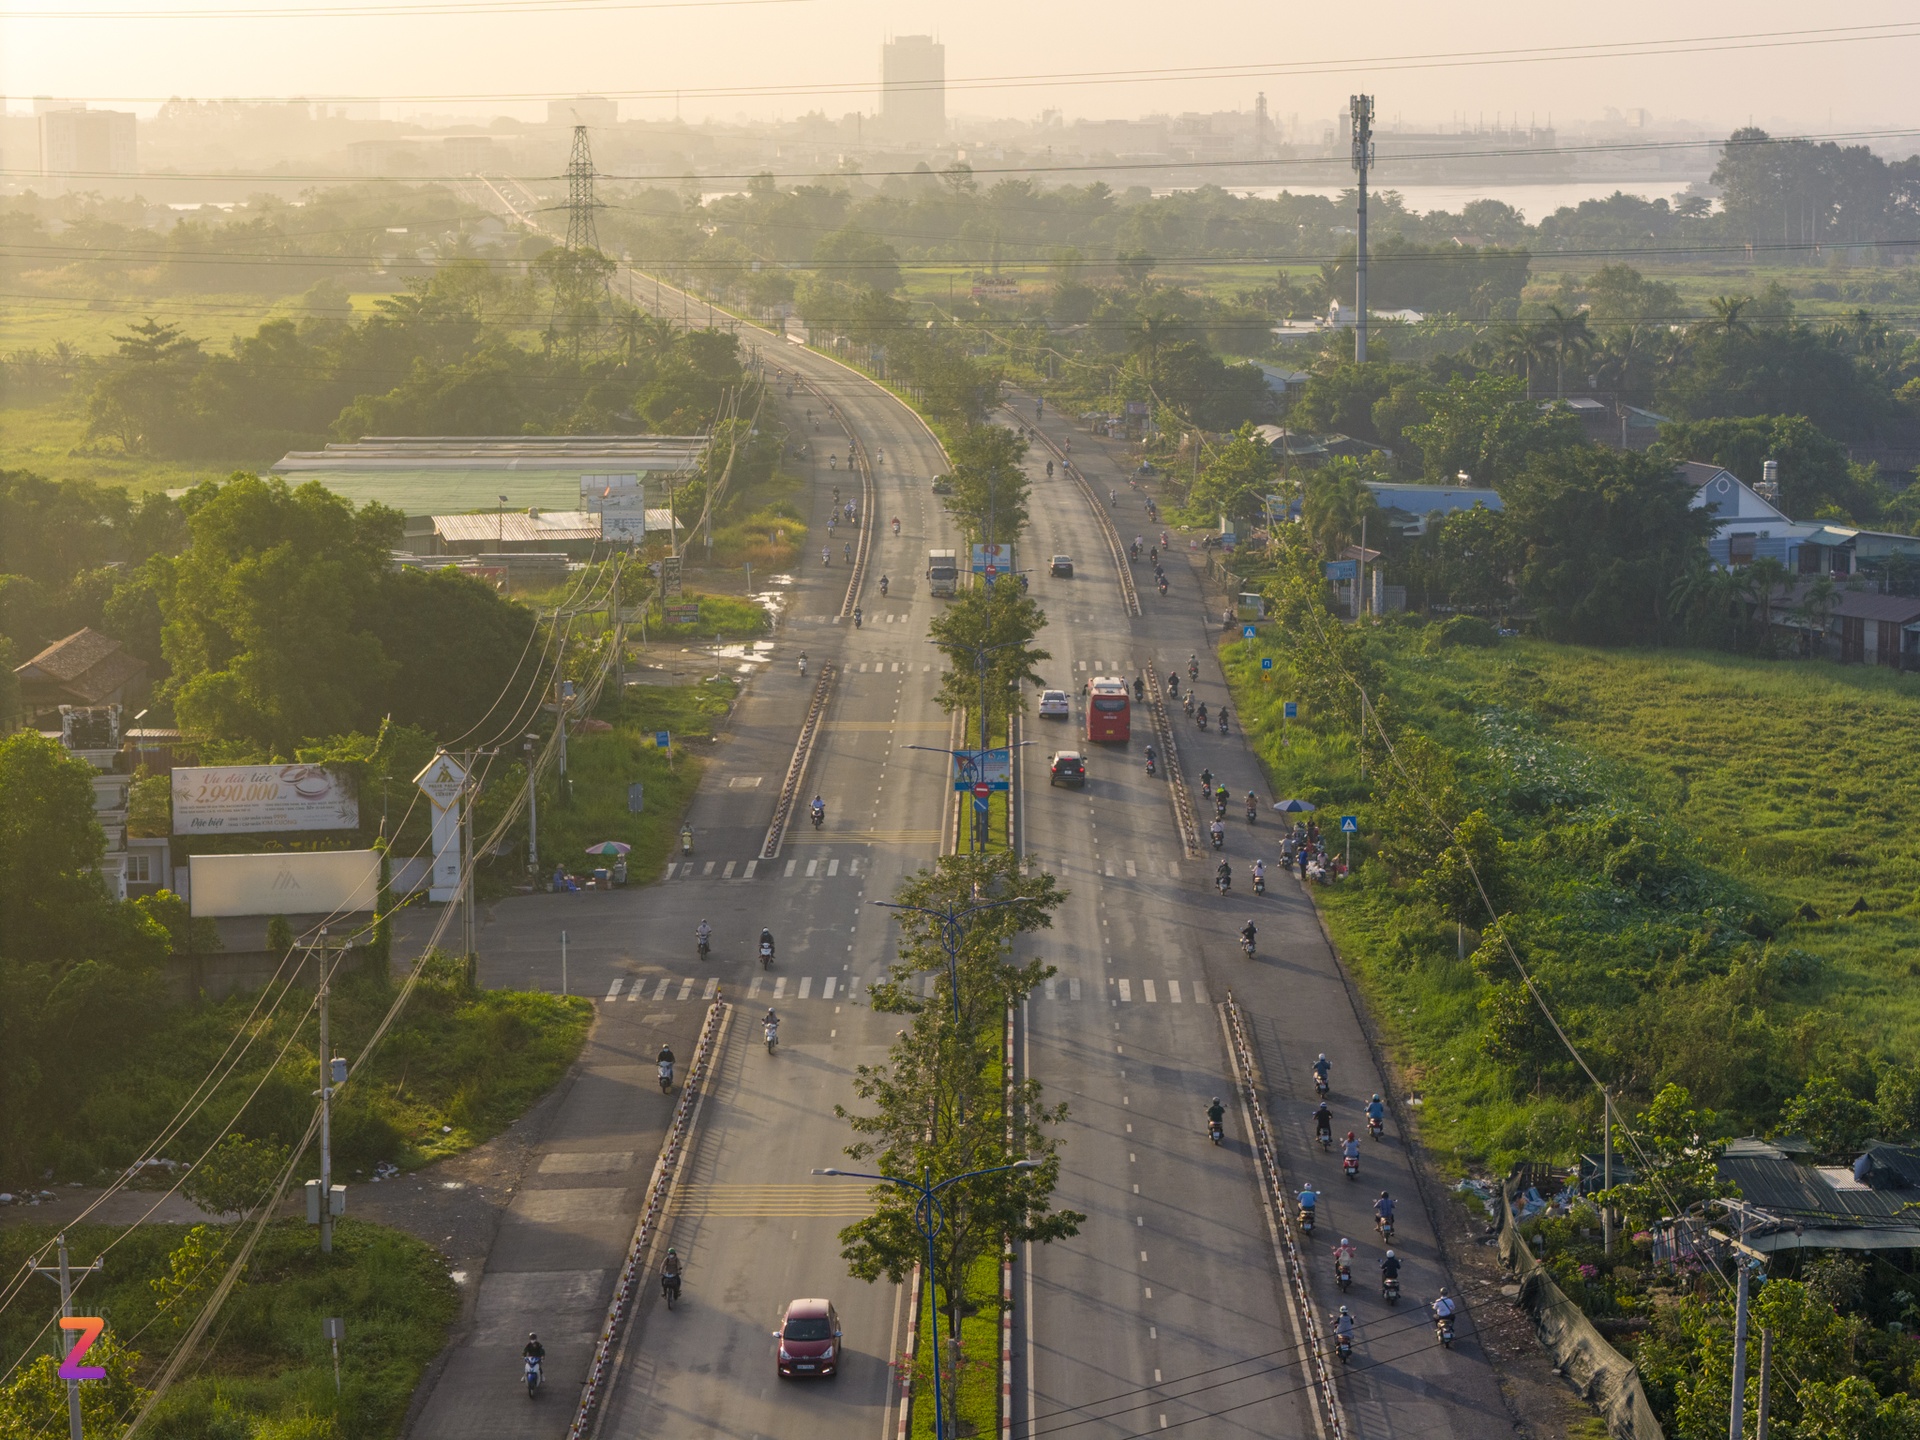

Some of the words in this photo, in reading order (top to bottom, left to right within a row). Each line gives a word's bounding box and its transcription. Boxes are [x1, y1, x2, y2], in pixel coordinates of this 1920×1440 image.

[195, 783, 278, 804] 2.990.000
[191, 817, 207, 829] Đặc
[208, 817, 224, 829] biệt
